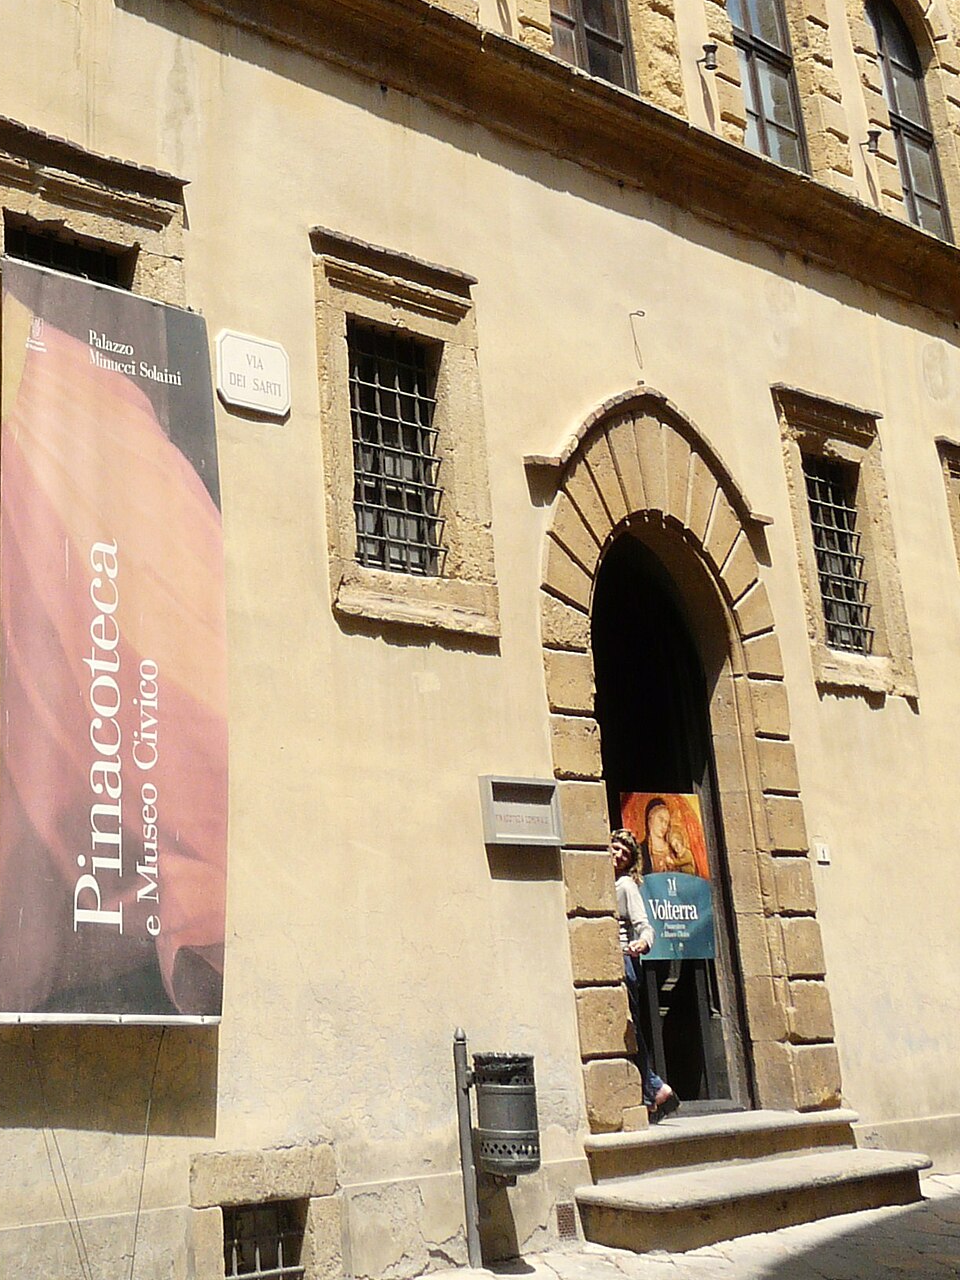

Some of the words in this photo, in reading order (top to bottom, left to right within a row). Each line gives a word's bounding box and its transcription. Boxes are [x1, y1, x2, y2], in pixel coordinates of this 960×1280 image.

[89, 329, 134, 356] Palazzo
[89, 349, 137, 376] Minucci
[139, 361, 182, 386] Solaini
[246, 353, 264, 371] VIA
[229, 372, 246, 389] DEI
[252, 377, 282, 398] SARTI
[131, 659, 159, 771] Civico
[73, 538, 123, 935] Pinacoteca
[136, 783, 160, 904] Museo
[648, 898, 699, 920] Volterra
[146, 915, 161, 937] e
